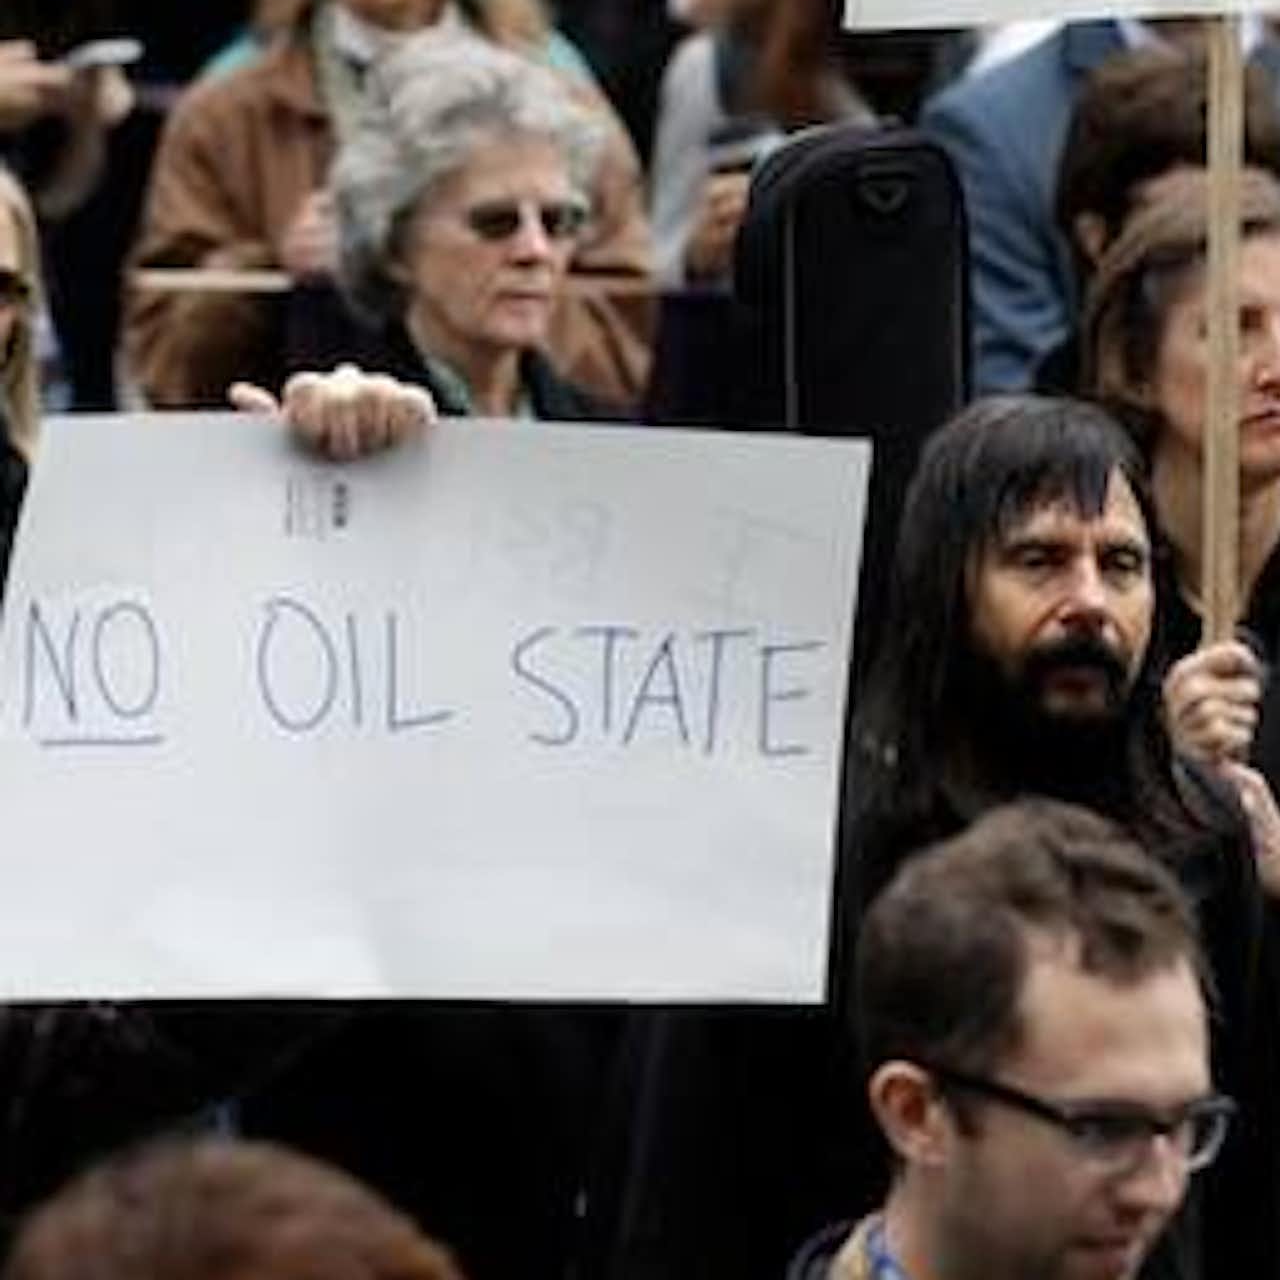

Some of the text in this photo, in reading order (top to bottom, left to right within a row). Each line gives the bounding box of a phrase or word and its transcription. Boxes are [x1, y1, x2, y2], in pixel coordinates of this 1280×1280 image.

[22, 596, 827, 758] NO OIL STATE
